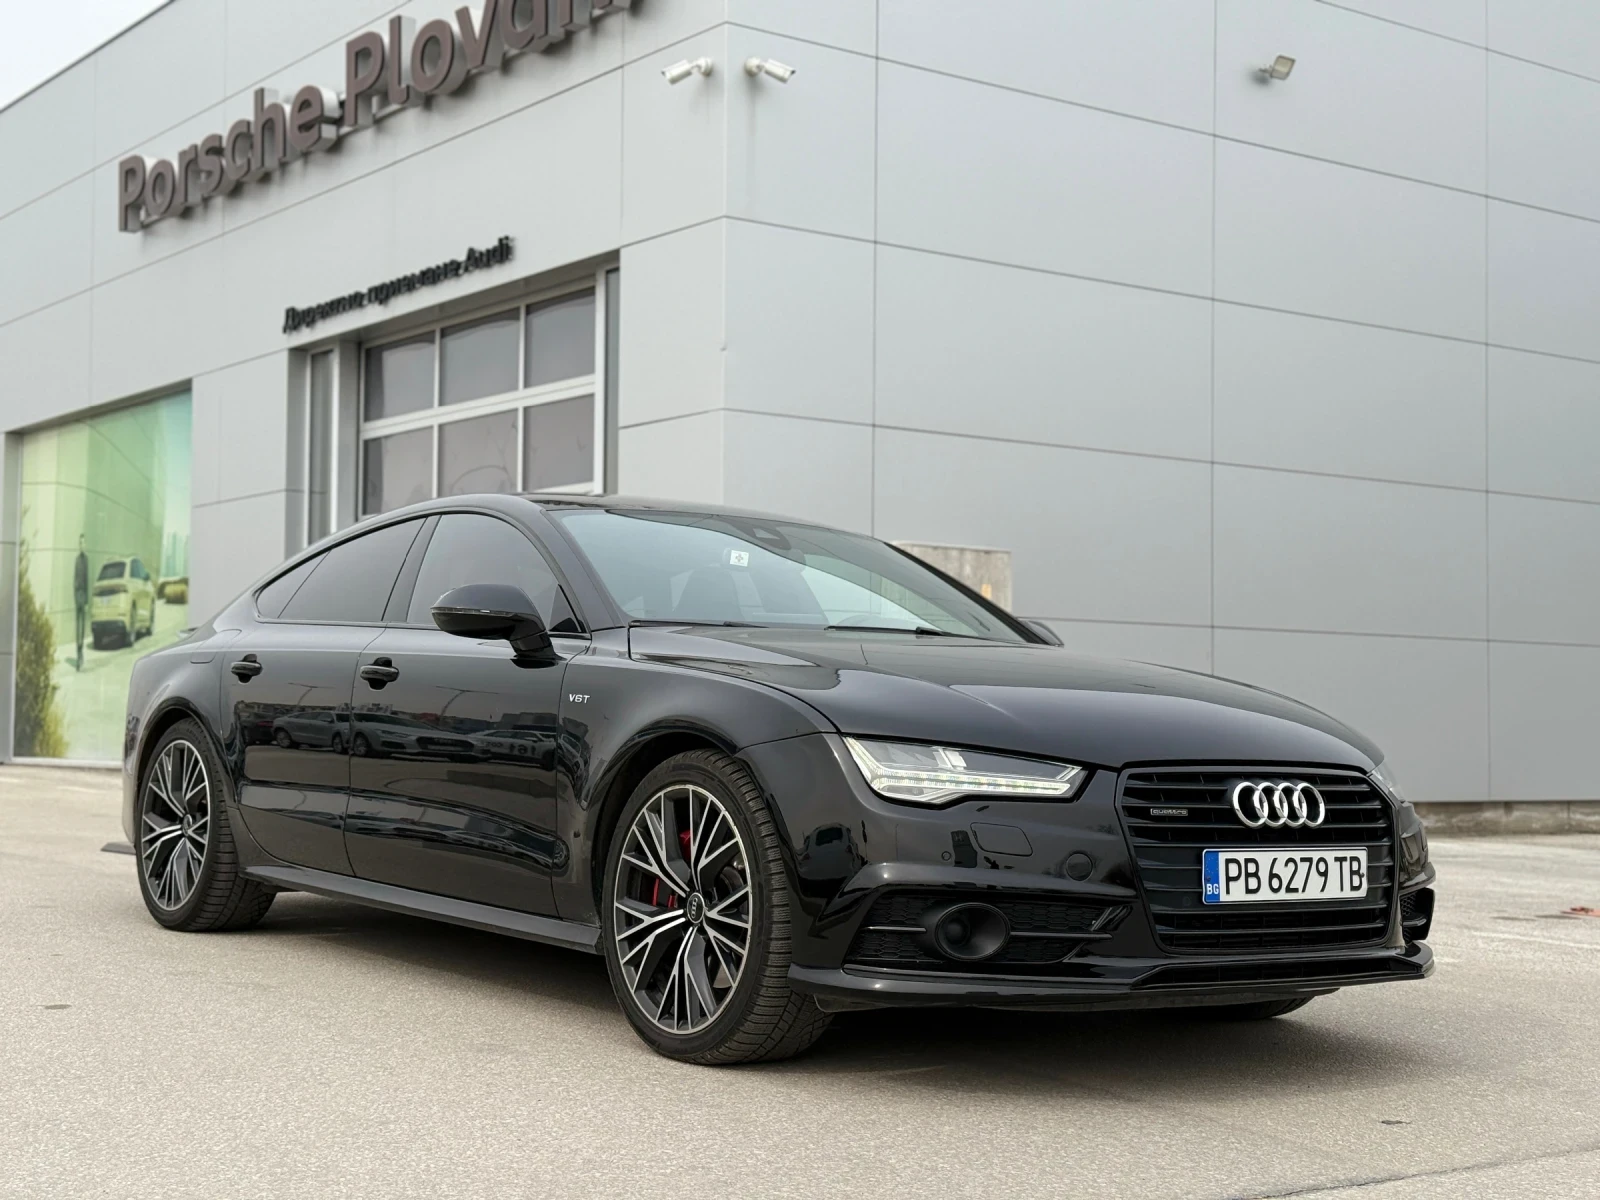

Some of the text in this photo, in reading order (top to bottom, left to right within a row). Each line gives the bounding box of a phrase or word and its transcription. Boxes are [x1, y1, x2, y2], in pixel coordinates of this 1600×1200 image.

[118, 0, 626, 232] Porsche Plov
[464, 235, 514, 273] Audi
[569, 693, 590, 704] V6T
[1206, 883, 1219, 895] BG
[1225, 856, 1363, 895] PB 6279 TB
